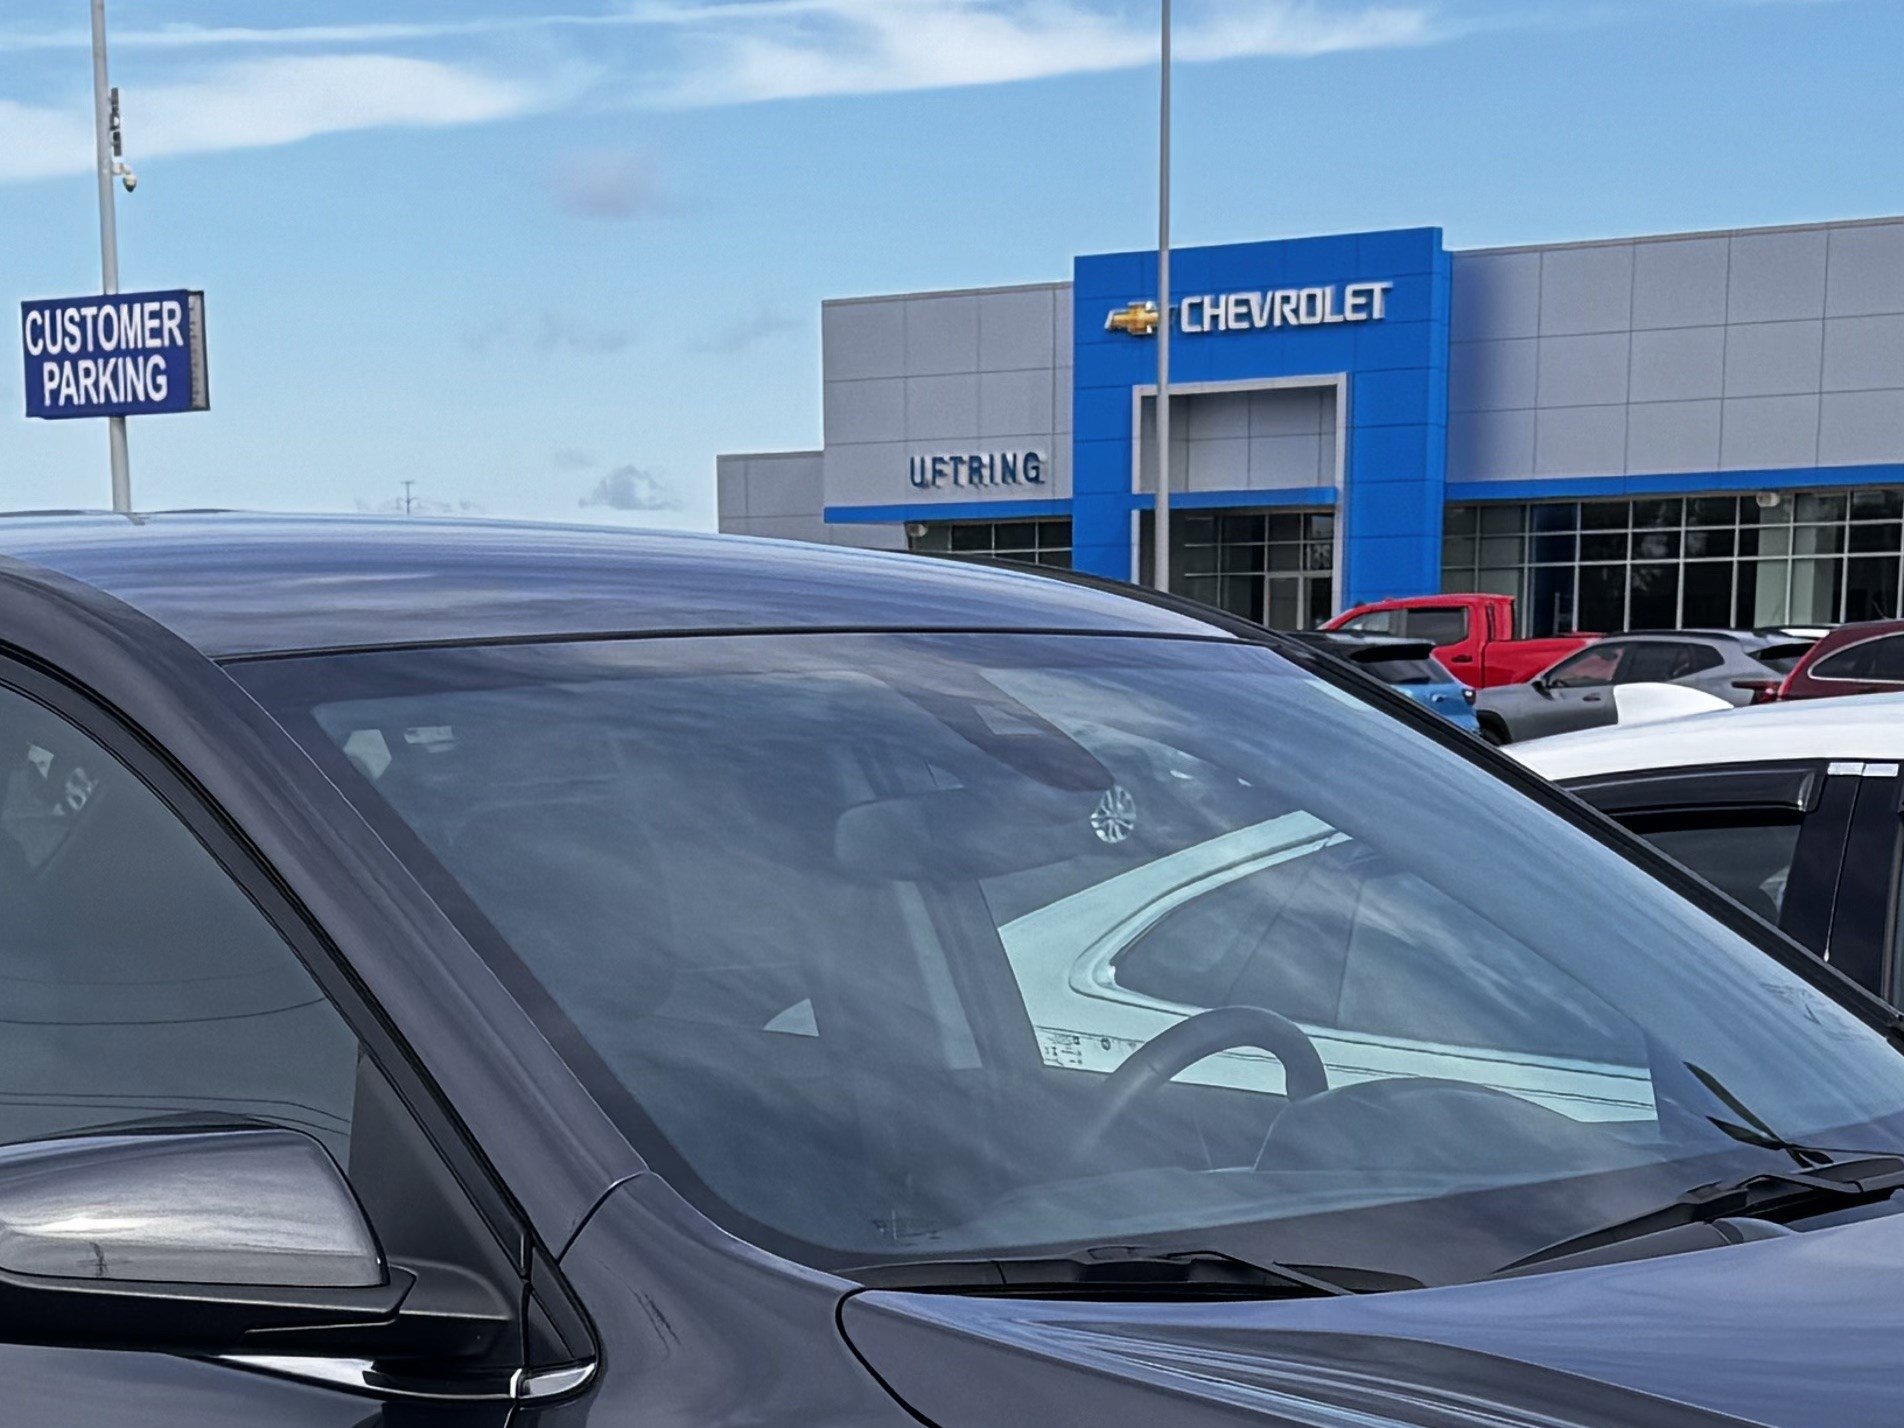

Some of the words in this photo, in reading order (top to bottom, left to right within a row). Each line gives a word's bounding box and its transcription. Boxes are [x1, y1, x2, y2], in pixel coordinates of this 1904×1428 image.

[25, 300, 184, 356] CUSTOMER
[1180, 281, 1394, 335] CHEVROLET
[43, 355, 168, 407] PARKING
[908, 450, 1045, 490] UFTRING
